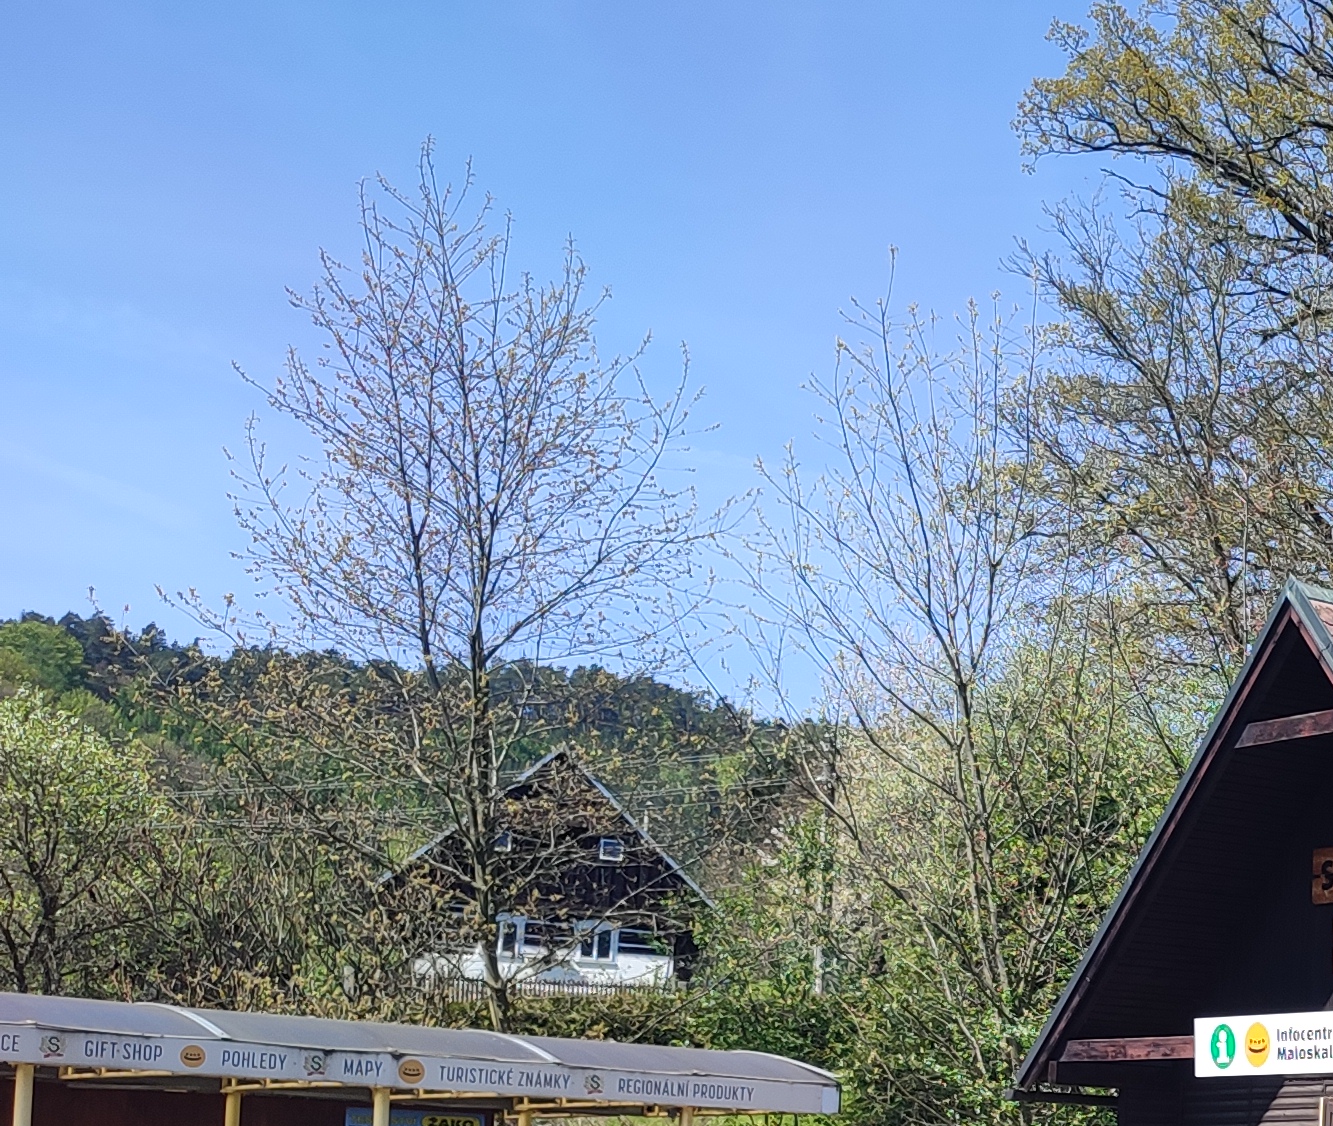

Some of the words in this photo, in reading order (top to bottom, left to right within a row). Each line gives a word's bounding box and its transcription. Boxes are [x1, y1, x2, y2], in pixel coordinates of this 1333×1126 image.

[84, 1040, 118, 1058] GIFT
[122, 1043, 163, 1062] SHOP
[221, 1050, 288, 1070] POHLEDY
[343, 1058, 383, 1078] MAPY
[439, 1065, 513, 1087] TURISTICKÉ
[517, 1070, 571, 1089] ZNÁMKY
[618, 1077, 689, 1098] REGIONÁLNÍ
[693, 1084, 755, 1102] PRODUKTY
